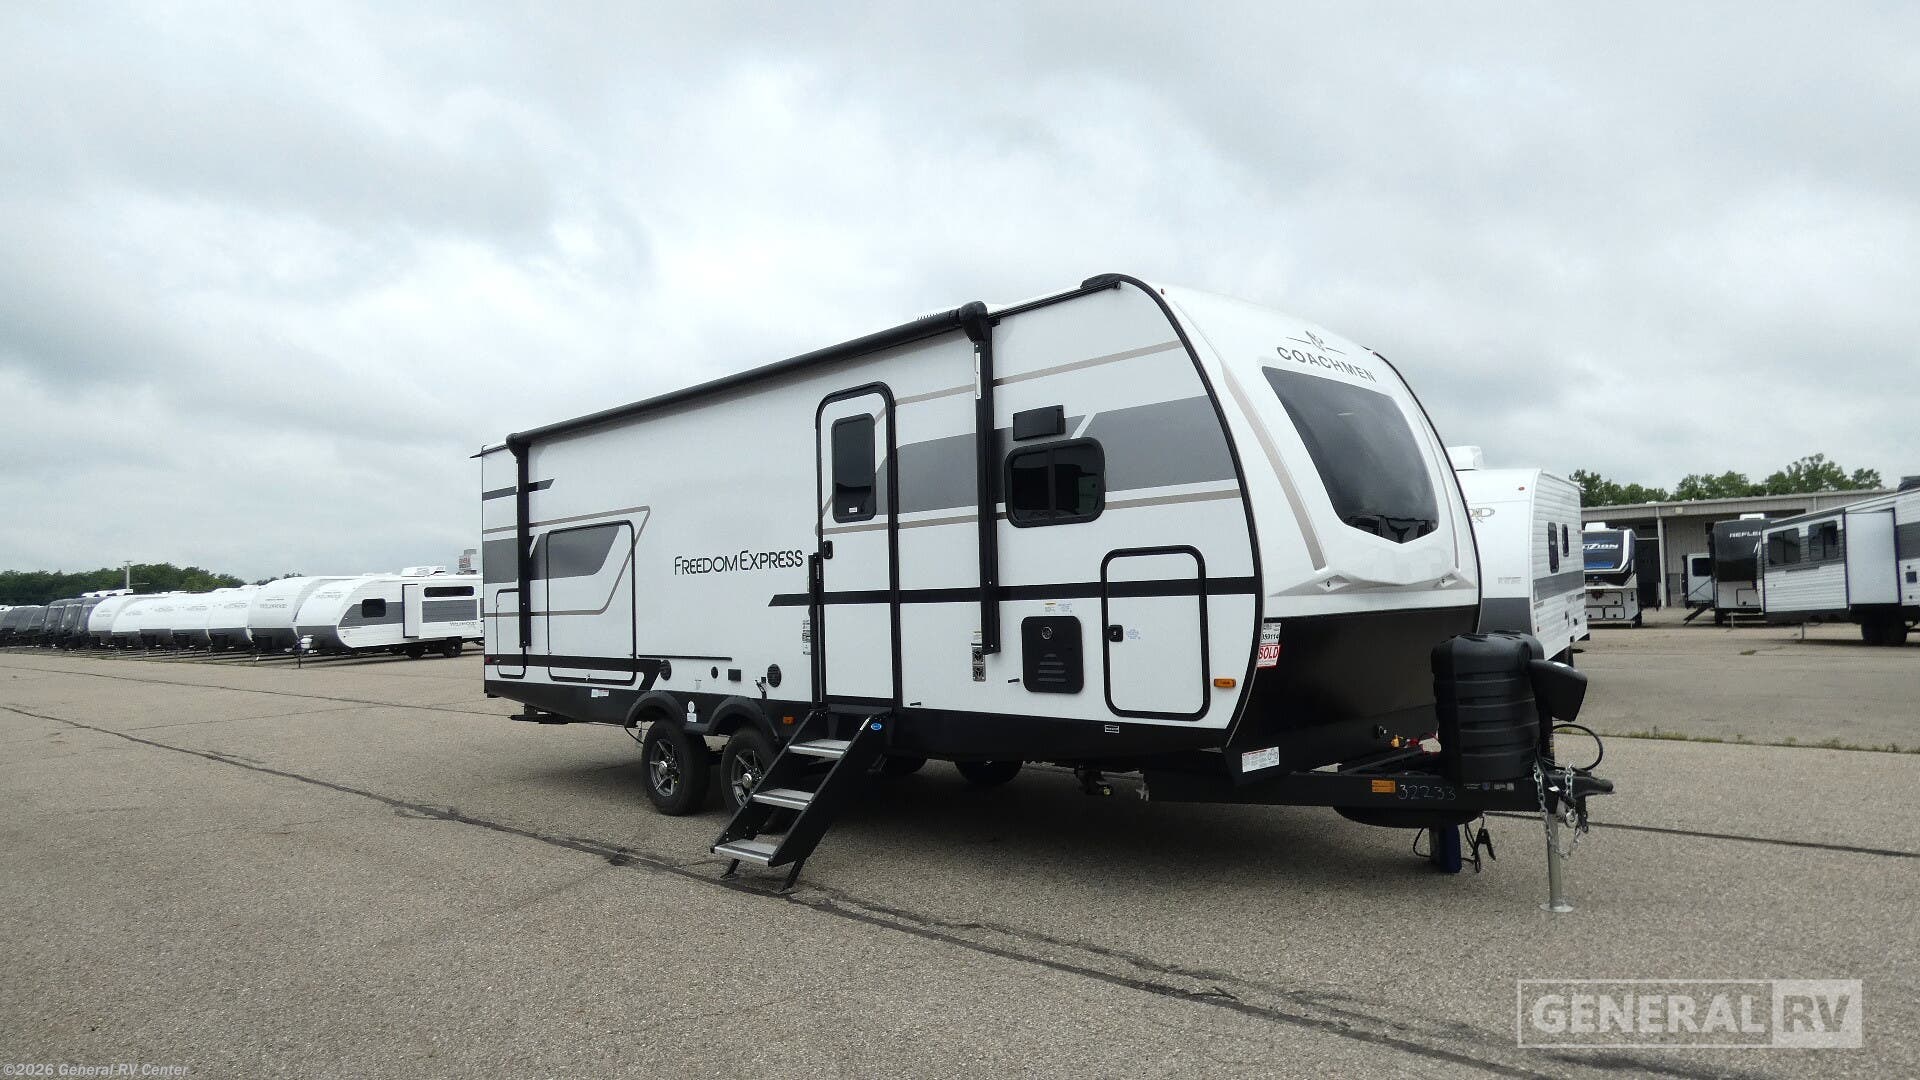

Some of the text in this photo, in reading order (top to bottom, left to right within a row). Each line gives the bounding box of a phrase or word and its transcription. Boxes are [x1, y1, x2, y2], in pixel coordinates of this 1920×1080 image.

[1276, 346, 1377, 383] COACHMEN
[674, 549, 804, 576] FREEDOM EXPRESS
[1258, 646, 1279, 660] SOLD
